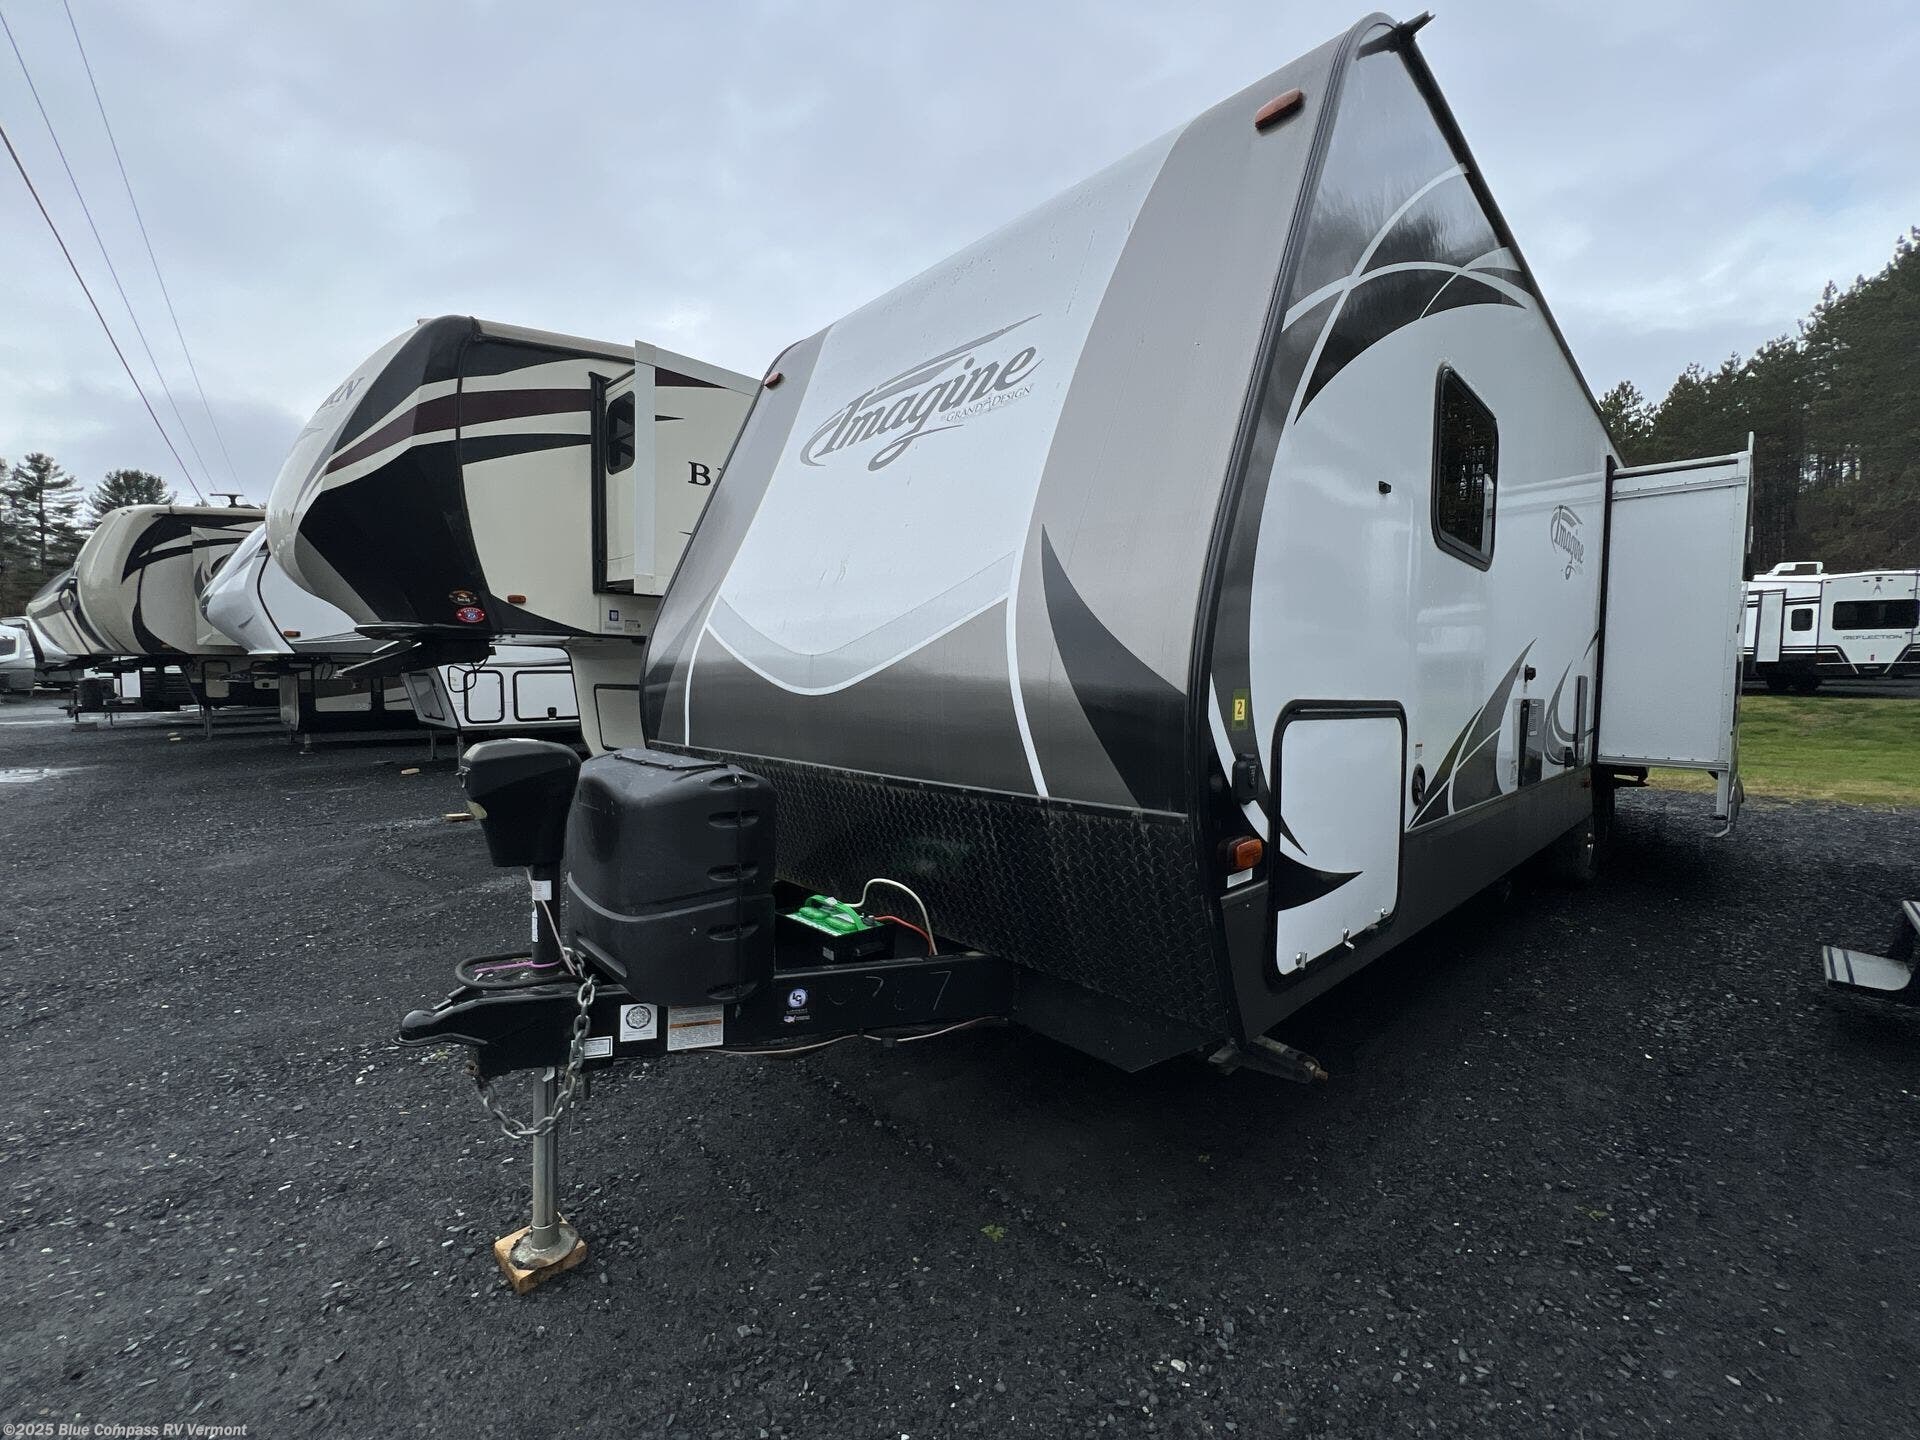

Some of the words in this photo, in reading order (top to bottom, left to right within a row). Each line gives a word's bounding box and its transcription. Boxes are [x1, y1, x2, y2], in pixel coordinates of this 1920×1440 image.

[799, 345, 1044, 471] Imagine
[946, 402, 983, 421] GRAND
[992, 383, 1034, 407] DESIGN
[1237, 701, 1243, 715] 2
